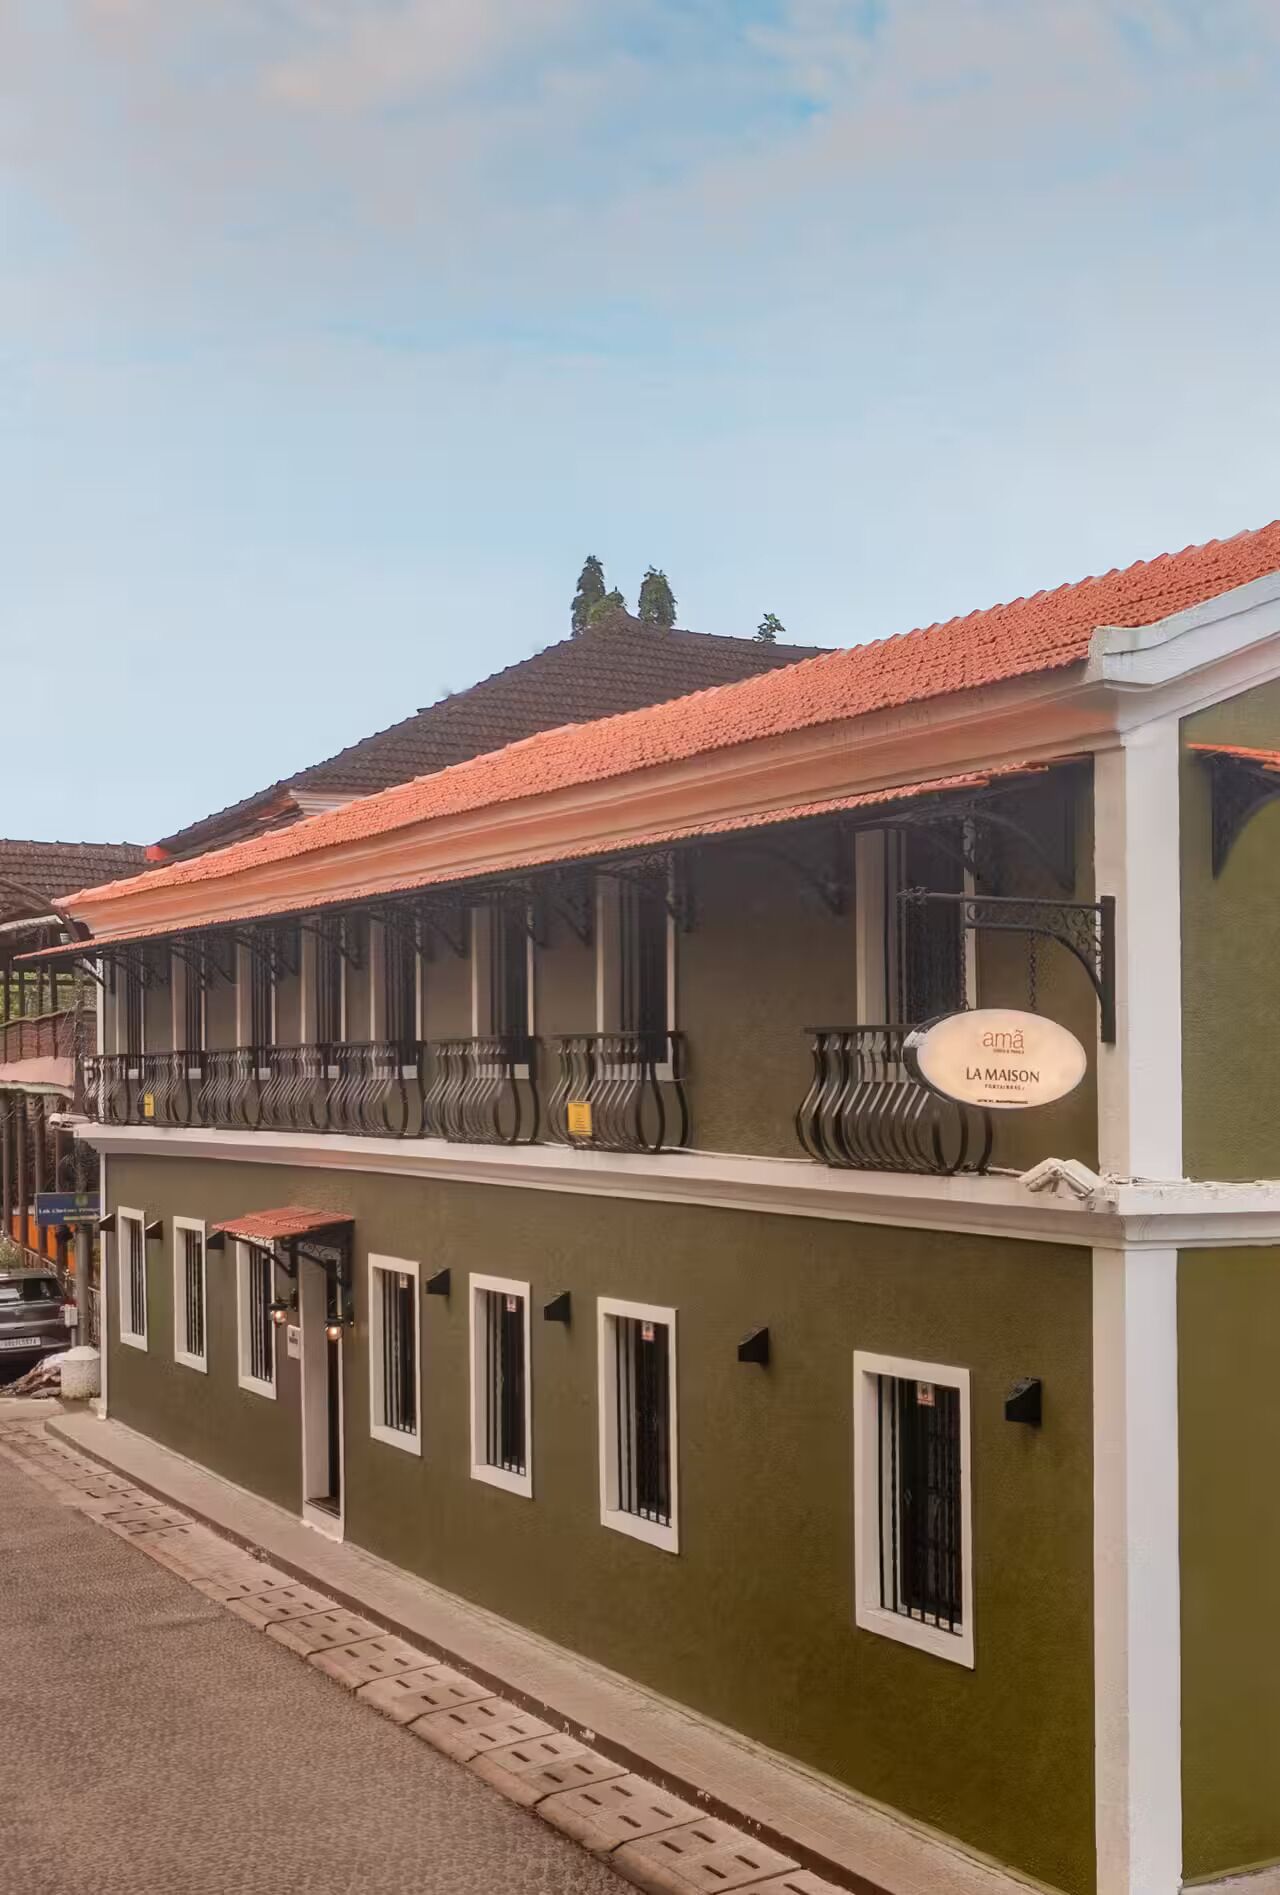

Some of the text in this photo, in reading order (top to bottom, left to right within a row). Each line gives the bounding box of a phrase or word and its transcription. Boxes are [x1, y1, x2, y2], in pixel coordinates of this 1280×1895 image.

[982, 1029, 1024, 1049] amã
[966, 1066, 1040, 1083] LA MAISON
